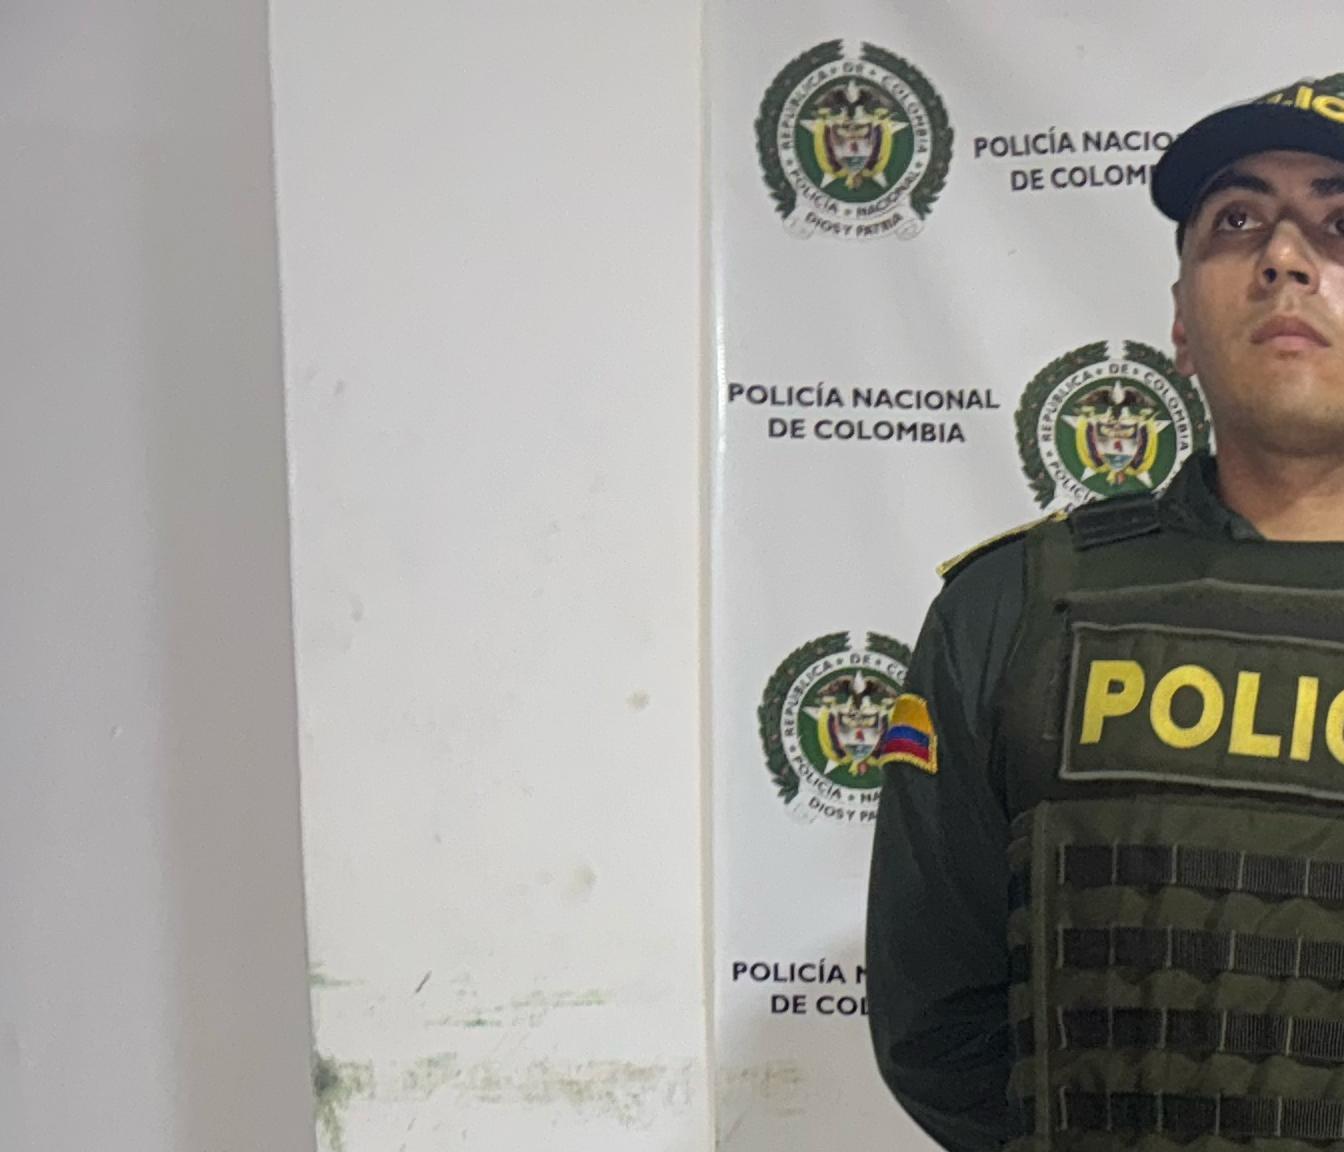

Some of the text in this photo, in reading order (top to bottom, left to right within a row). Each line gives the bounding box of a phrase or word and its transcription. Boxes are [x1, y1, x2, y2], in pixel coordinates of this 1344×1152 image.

[878, 72, 926, 152] COLOMBIA
[973, 126, 1176, 159] POLICÍA NACIO
[1010, 164, 1155, 192] DE COLOM
[855, 214, 905, 236] PATRIA
[728, 381, 1000, 411] POLICÍA NACIONAL
[1109, 365, 1132, 377] DE
[1144, 375, 1191, 453] COLOMBIA
[768, 417, 966, 443] DE COLOMBIA
[850, 654, 872, 666] DE
[732, 958, 847, 985] POLICÍA
[771, 994, 807, 1015] DE
